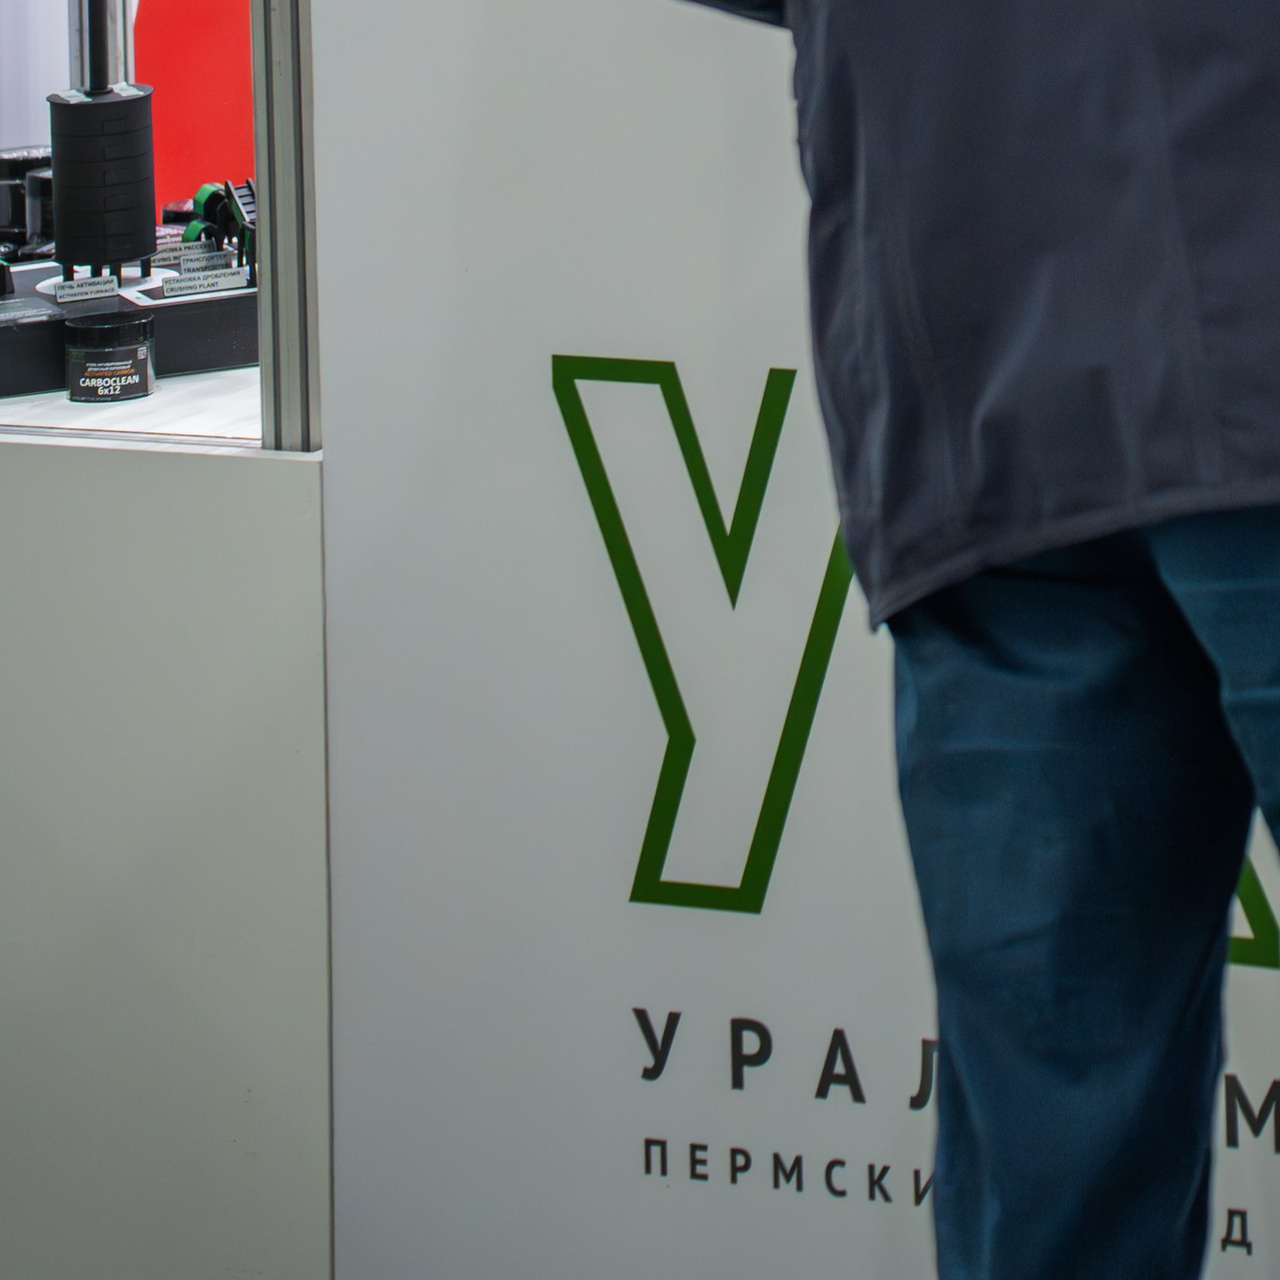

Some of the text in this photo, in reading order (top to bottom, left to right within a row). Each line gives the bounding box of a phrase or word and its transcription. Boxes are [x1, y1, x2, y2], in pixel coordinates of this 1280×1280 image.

[166, 280, 219, 294] CRUSHING PLANT
[79, 374, 139, 387] CARBOCLEAN
[97, 385, 121, 396] 6x12
[644, 1137, 936, 1207] ПЕРМСКИ
